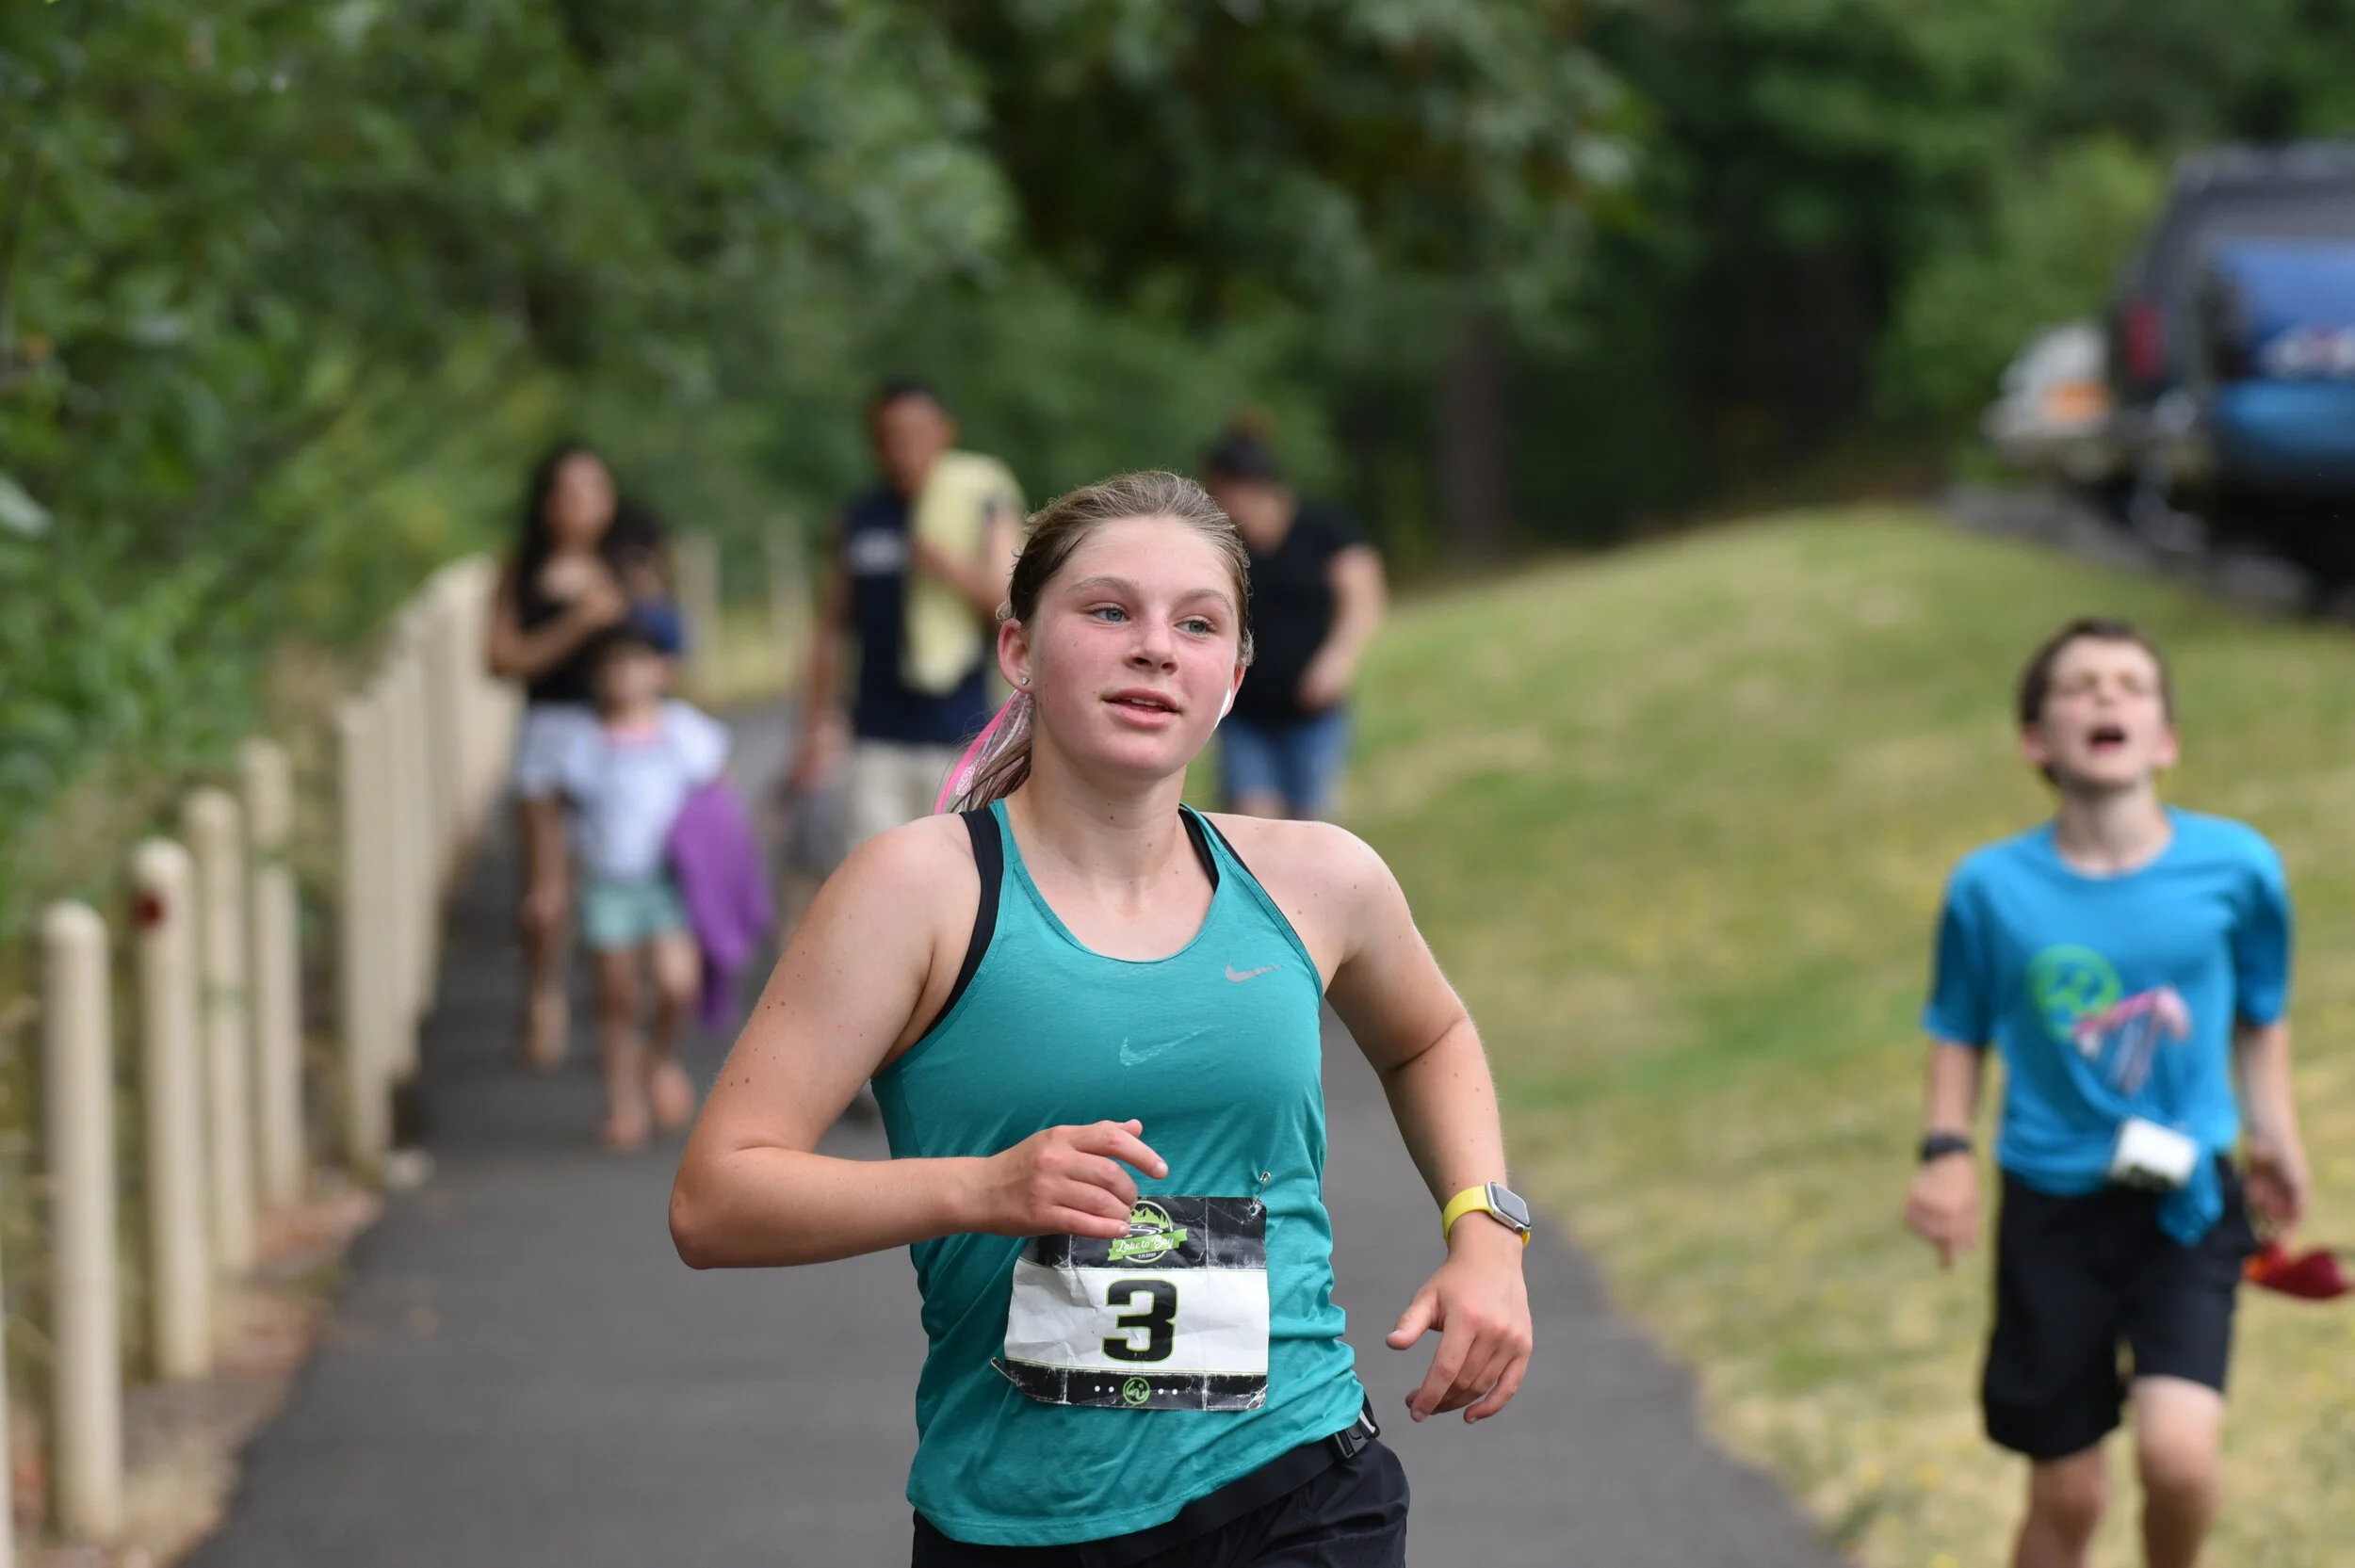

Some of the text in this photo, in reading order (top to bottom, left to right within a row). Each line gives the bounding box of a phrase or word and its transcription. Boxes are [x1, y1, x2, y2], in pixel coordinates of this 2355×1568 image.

[1115, 1235, 1174, 1253] Lake to Bay
[1101, 1277, 1178, 1363] 3
